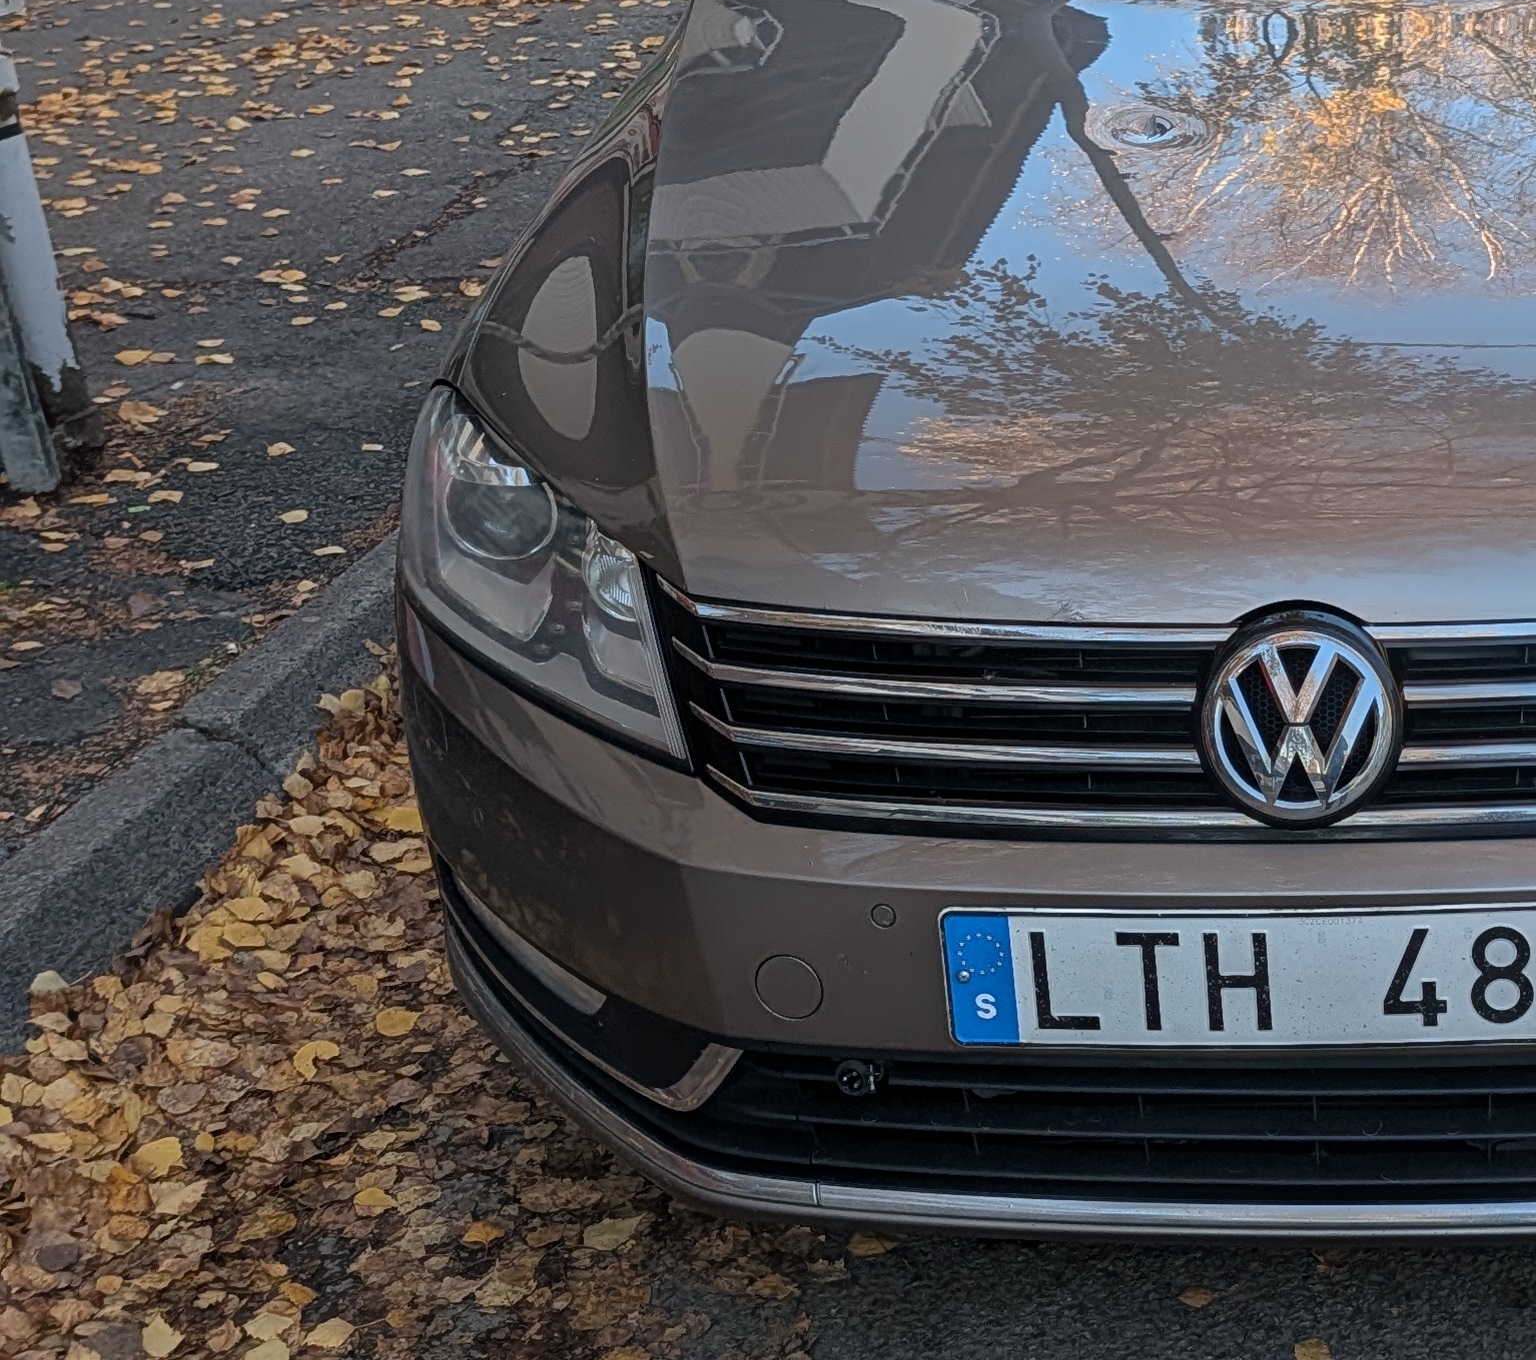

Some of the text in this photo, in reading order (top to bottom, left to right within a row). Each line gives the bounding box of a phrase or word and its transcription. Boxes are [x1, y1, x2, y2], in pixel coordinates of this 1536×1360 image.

[1215, 634, 1385, 812] VW
[975, 993, 997, 1019] S
[1028, 929, 1273, 1031] LTH
